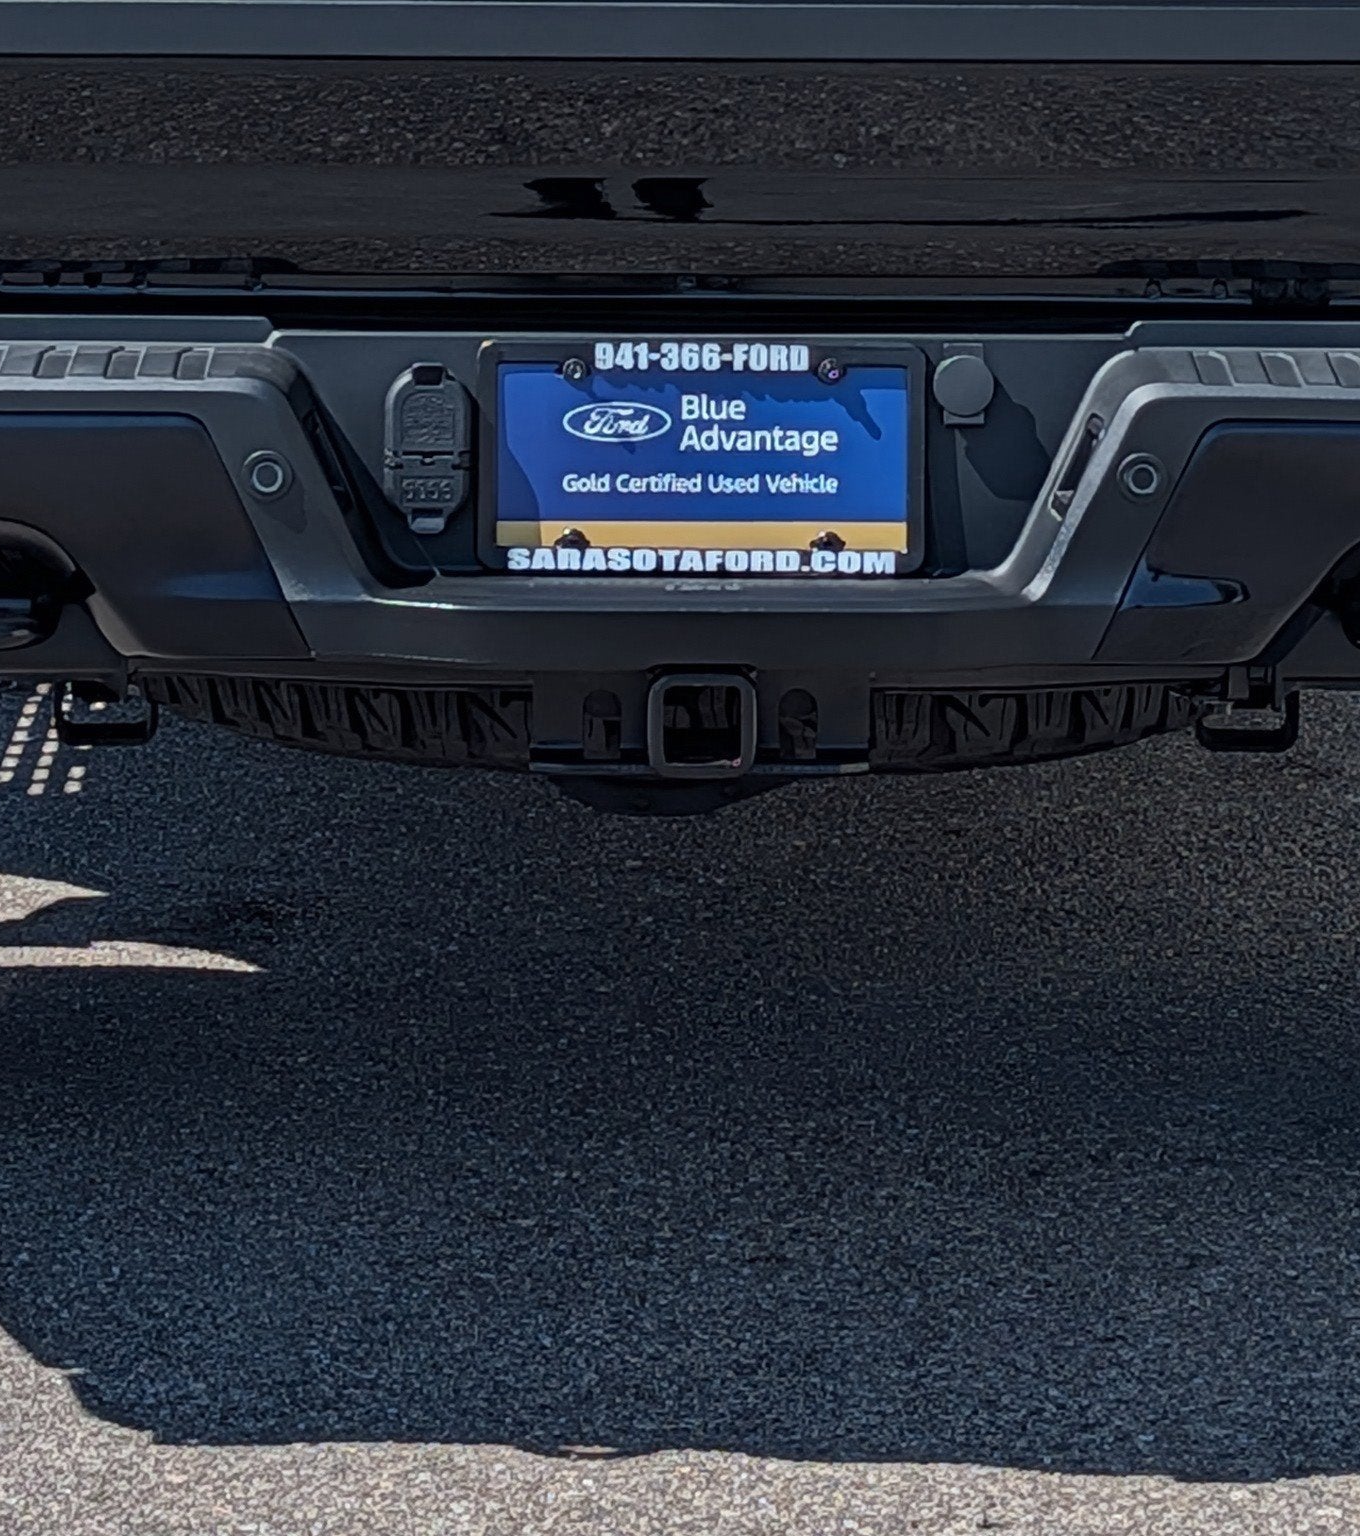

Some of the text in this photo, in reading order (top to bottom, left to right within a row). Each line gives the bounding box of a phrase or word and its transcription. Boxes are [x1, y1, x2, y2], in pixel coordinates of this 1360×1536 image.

[595, 342, 810, 372] 941-366-FORD
[583, 407, 650, 435] Ford
[681, 394, 746, 421] Blue
[679, 425, 838, 457] Advantage
[562, 472, 839, 495] Gold Certified Used Vehicle
[507, 547, 897, 574] SARASOTAFORD.COM
